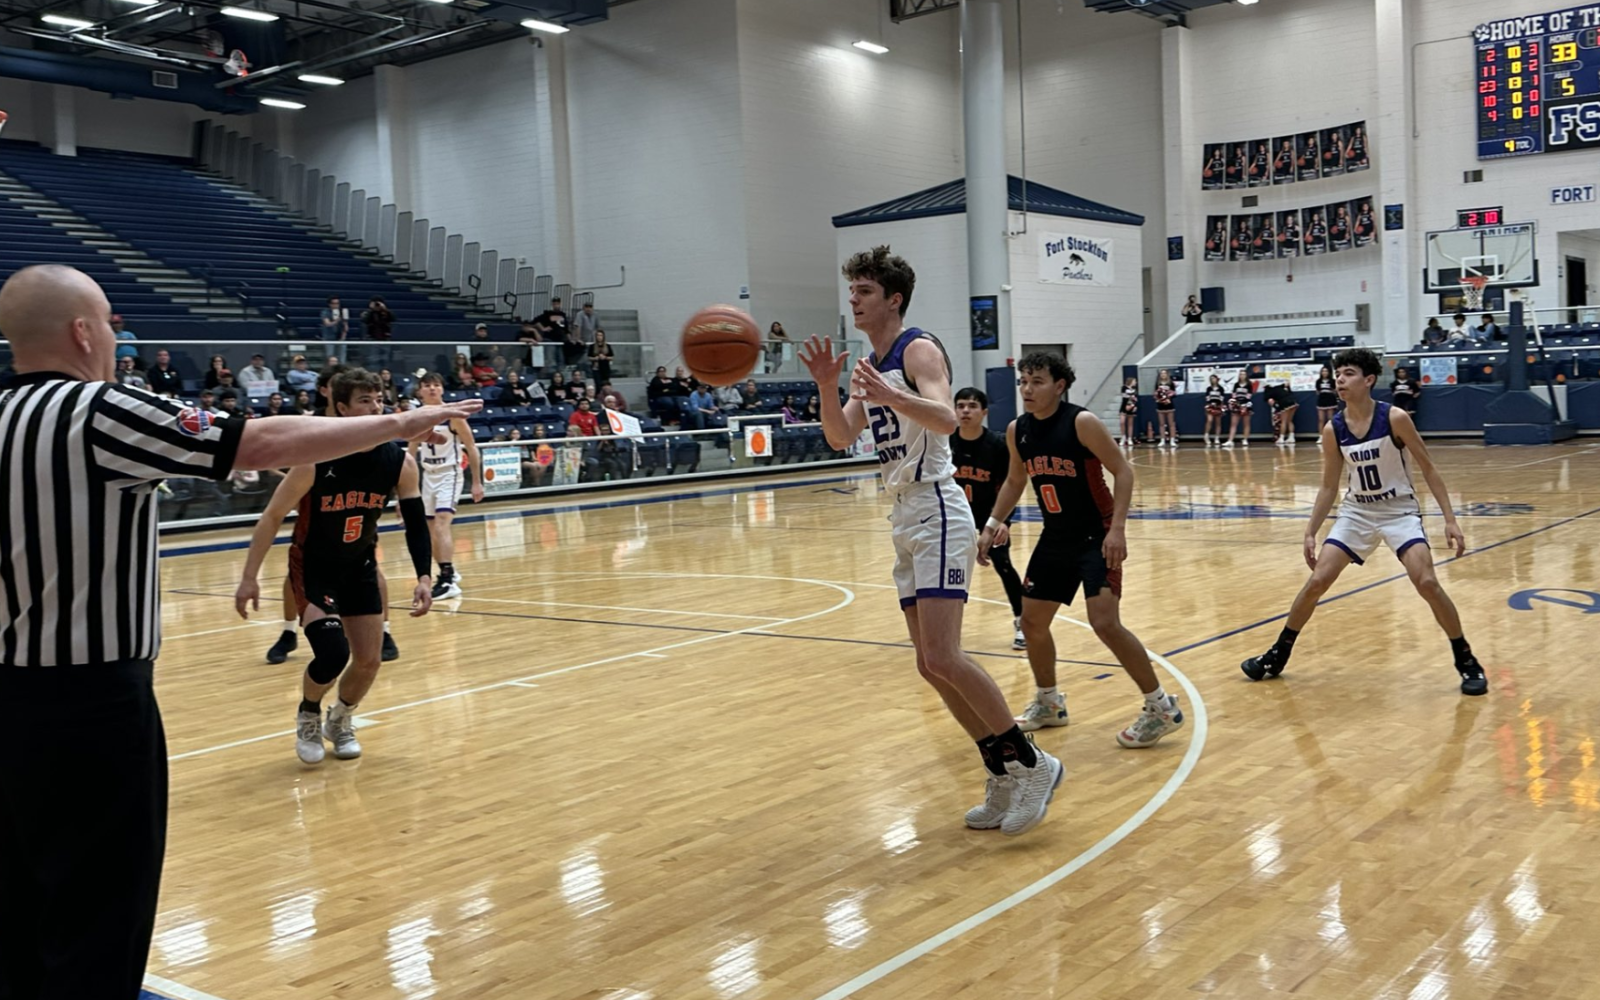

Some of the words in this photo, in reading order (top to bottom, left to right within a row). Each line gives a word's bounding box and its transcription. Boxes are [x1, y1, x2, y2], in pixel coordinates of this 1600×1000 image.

[1490, 16, 1545, 41] HOME
[1549, 11, 1575, 32] OF
[1529, 43, 1538, 56] 3
[1551, 42, 1577, 62] 33
[1528, 58, 1538, 71] 2
[1479, 80, 1497, 93] 23
[1561, 77, 1575, 96] 5
[1552, 186, 1593, 203] FORT
[1045, 239, 1065, 257] Fort
[1067, 236, 1108, 262] Stockton
[868, 405, 901, 444] 23
[1349, 447, 1380, 463] IRION
[953, 465, 991, 482] AGLES
[1023, 455, 1077, 478] AGLES
[1357, 464, 1382, 491] 10
[1040, 484, 1062, 513] 0
[1354, 487, 1396, 503] COUNTY
[343, 515, 364, 543] 5
